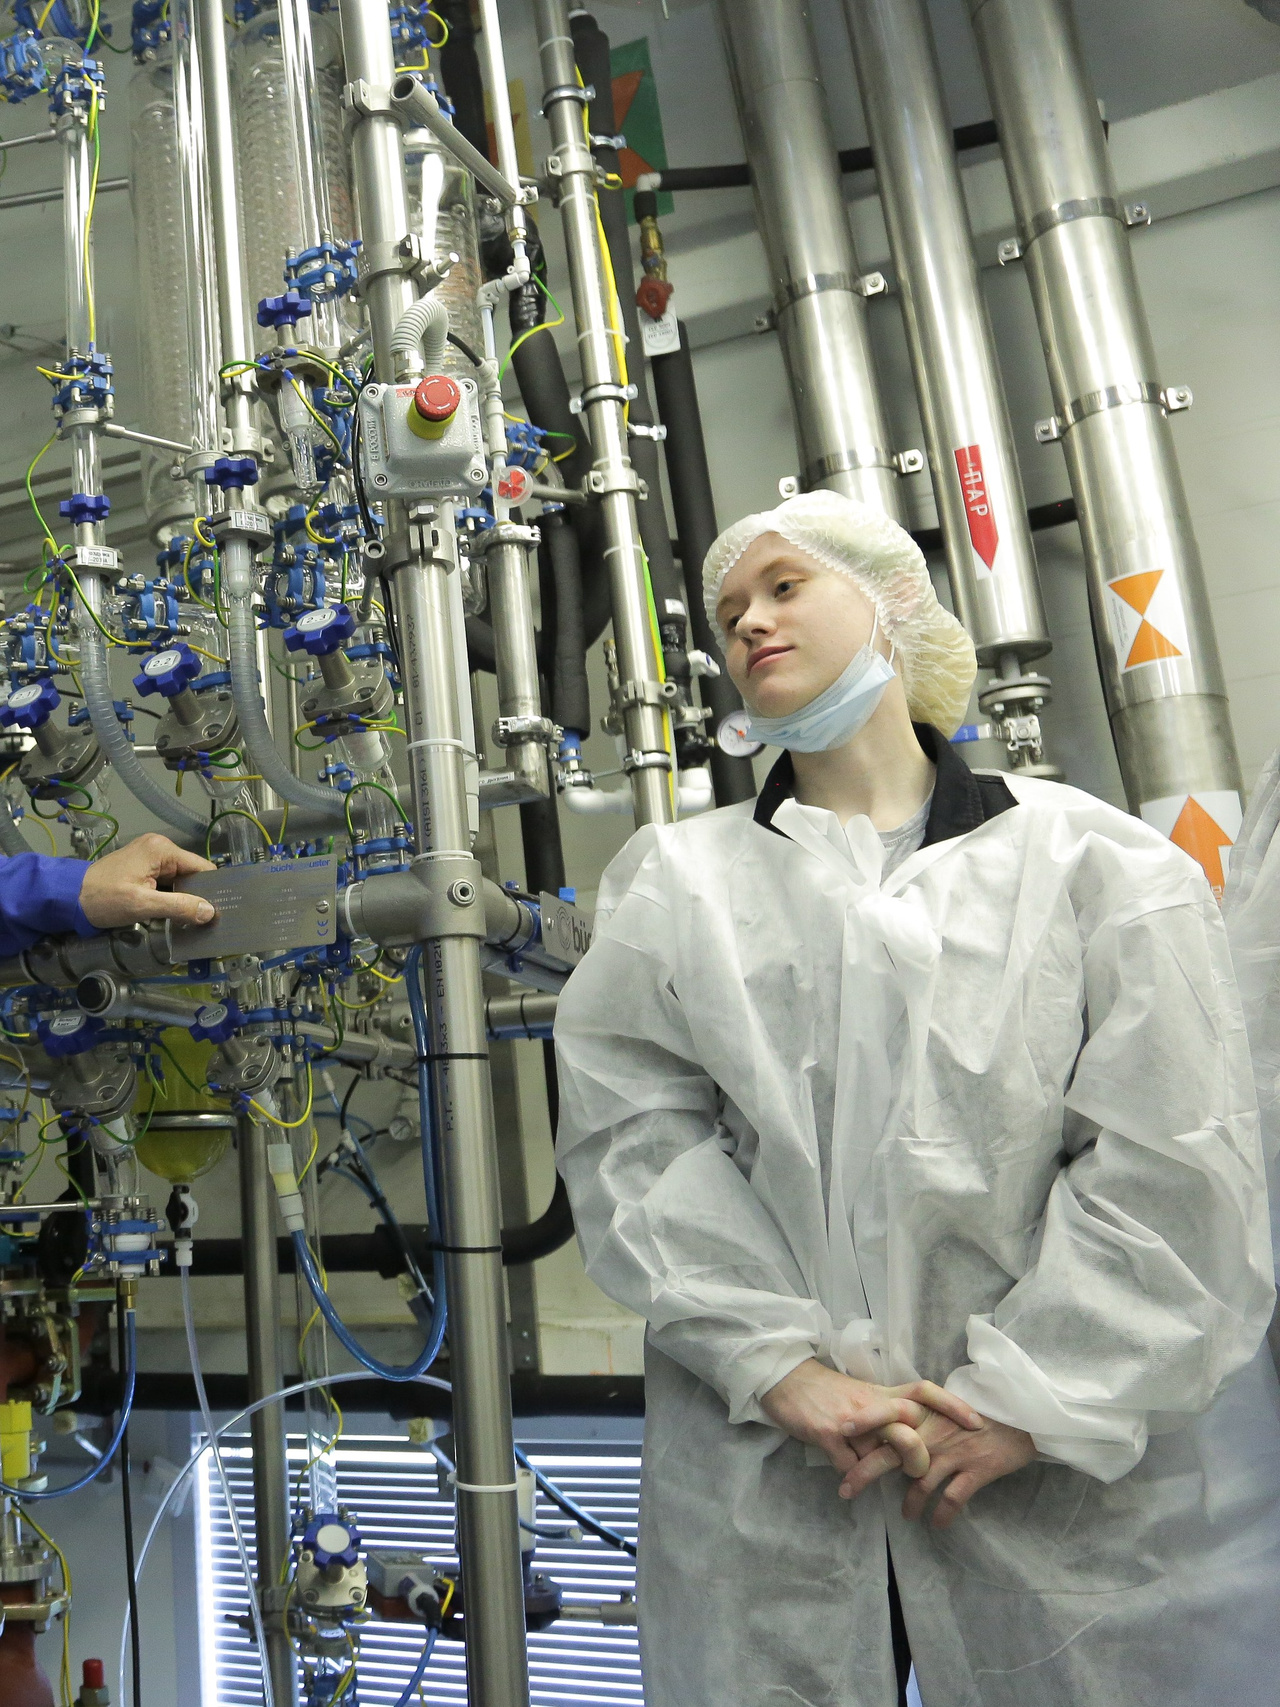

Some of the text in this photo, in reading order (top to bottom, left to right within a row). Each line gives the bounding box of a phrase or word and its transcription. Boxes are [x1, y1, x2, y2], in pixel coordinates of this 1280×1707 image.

[963, 470, 989, 517] ПАР
[306, 613, 326, 624] 2.3
[152, 657, 172, 668] 2.2
